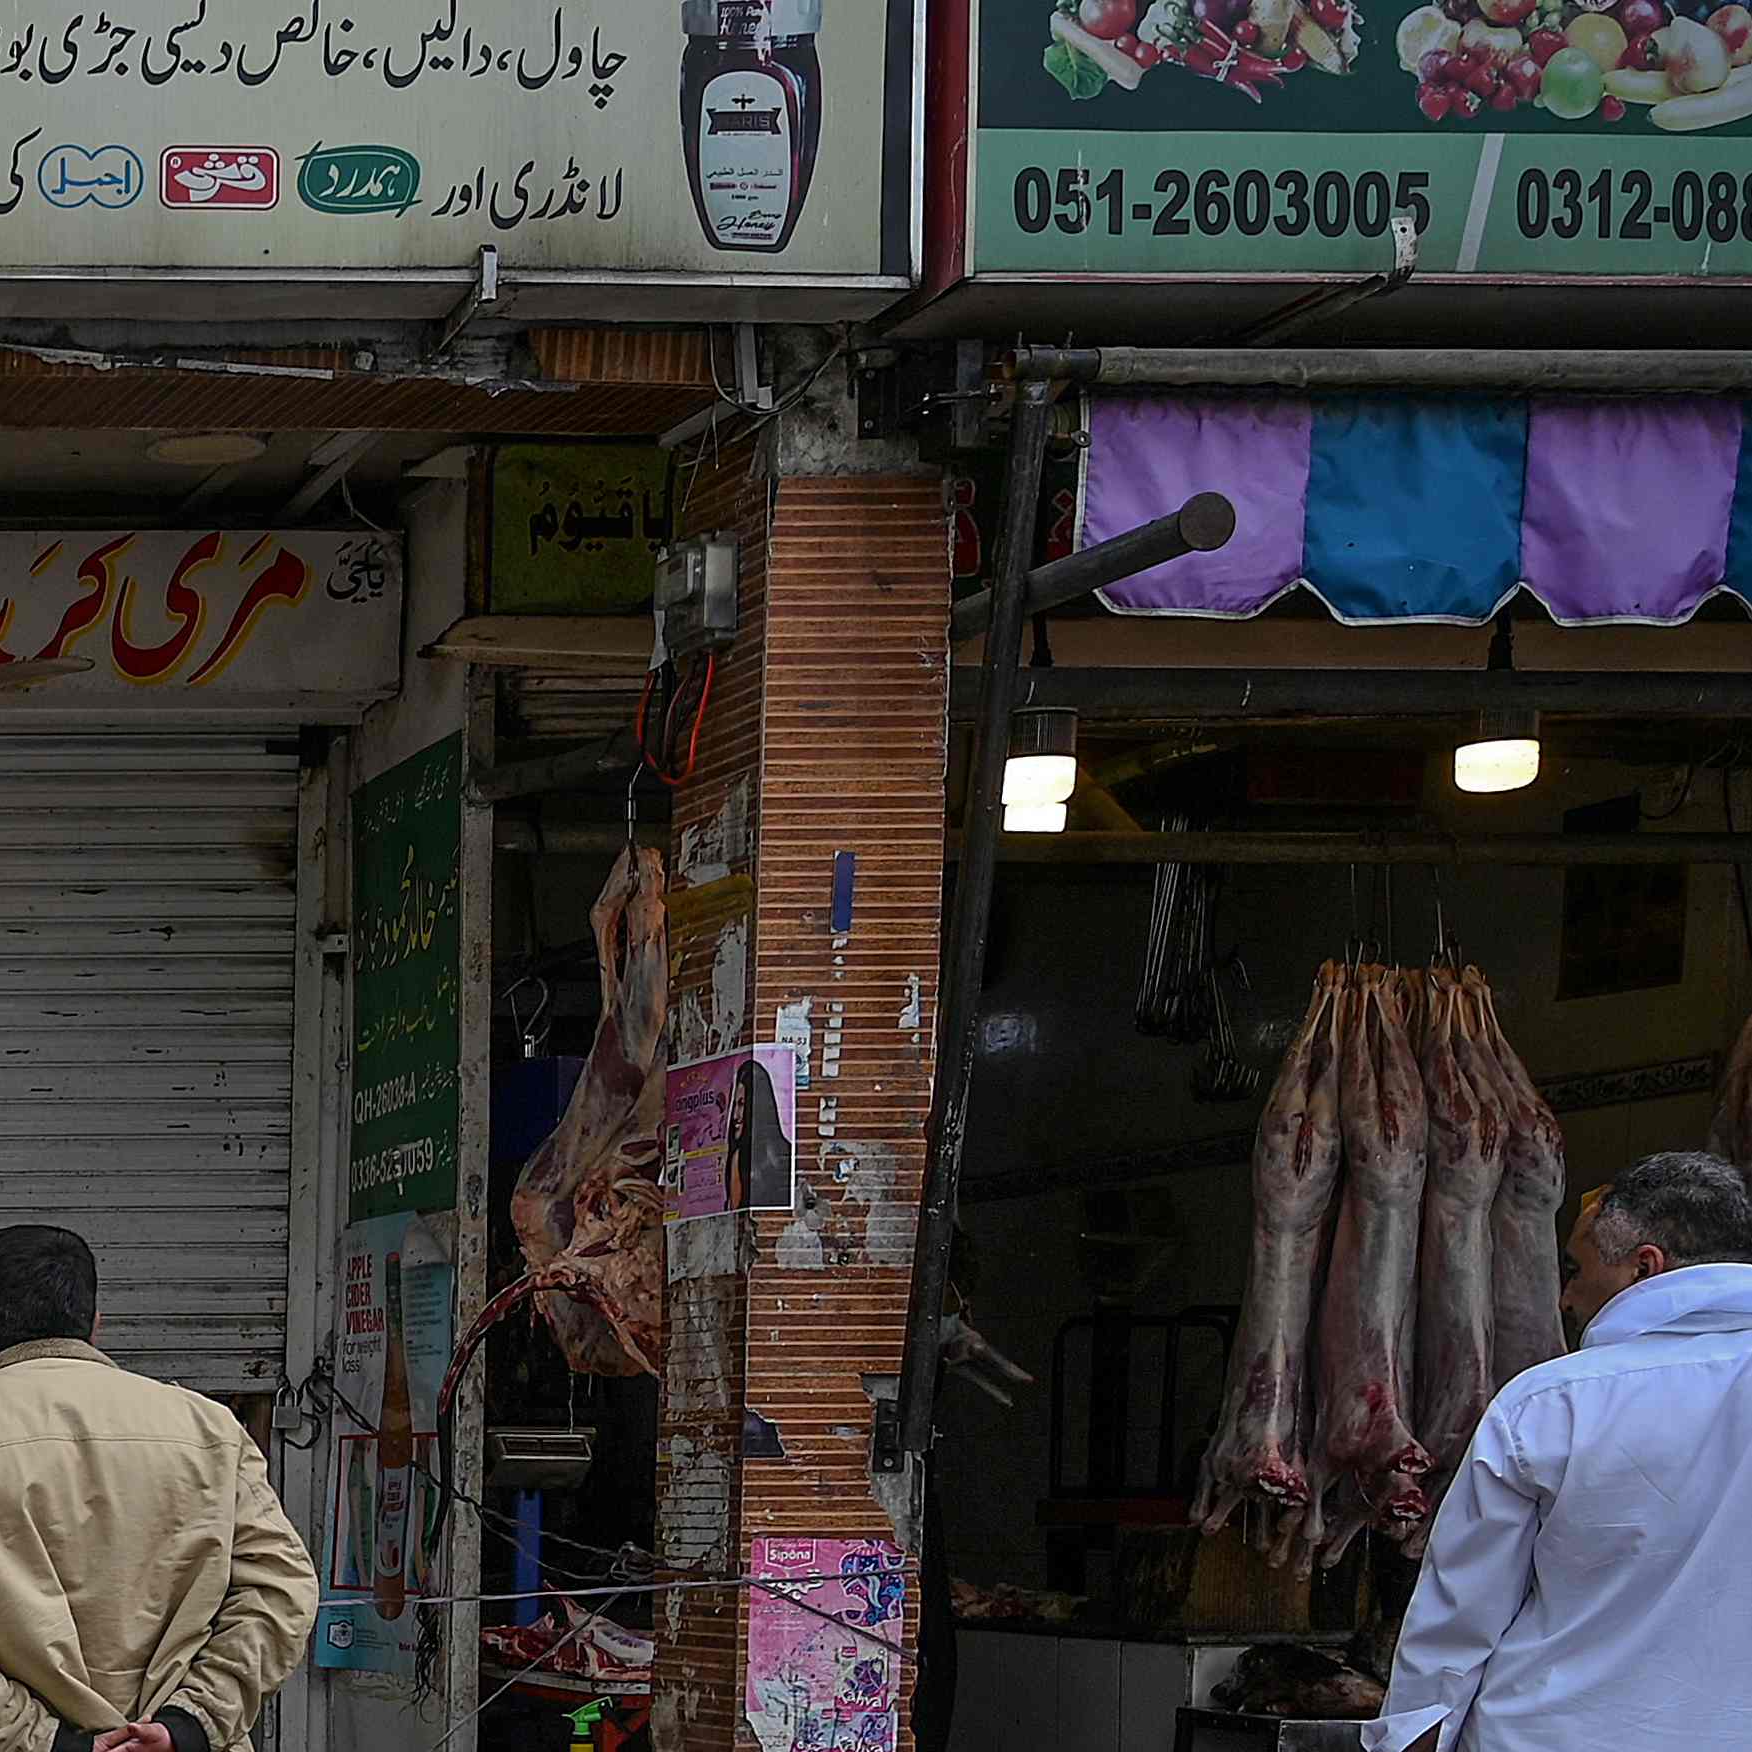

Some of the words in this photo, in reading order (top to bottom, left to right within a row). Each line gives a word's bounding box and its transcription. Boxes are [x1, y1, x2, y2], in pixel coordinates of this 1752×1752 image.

[430, 165, 485, 218] اور
[1012, 166, 1431, 238] 051-2603005
[345, 1281, 372, 1309] CIDER
[345, 1308, 385, 1336] VINEGAR
